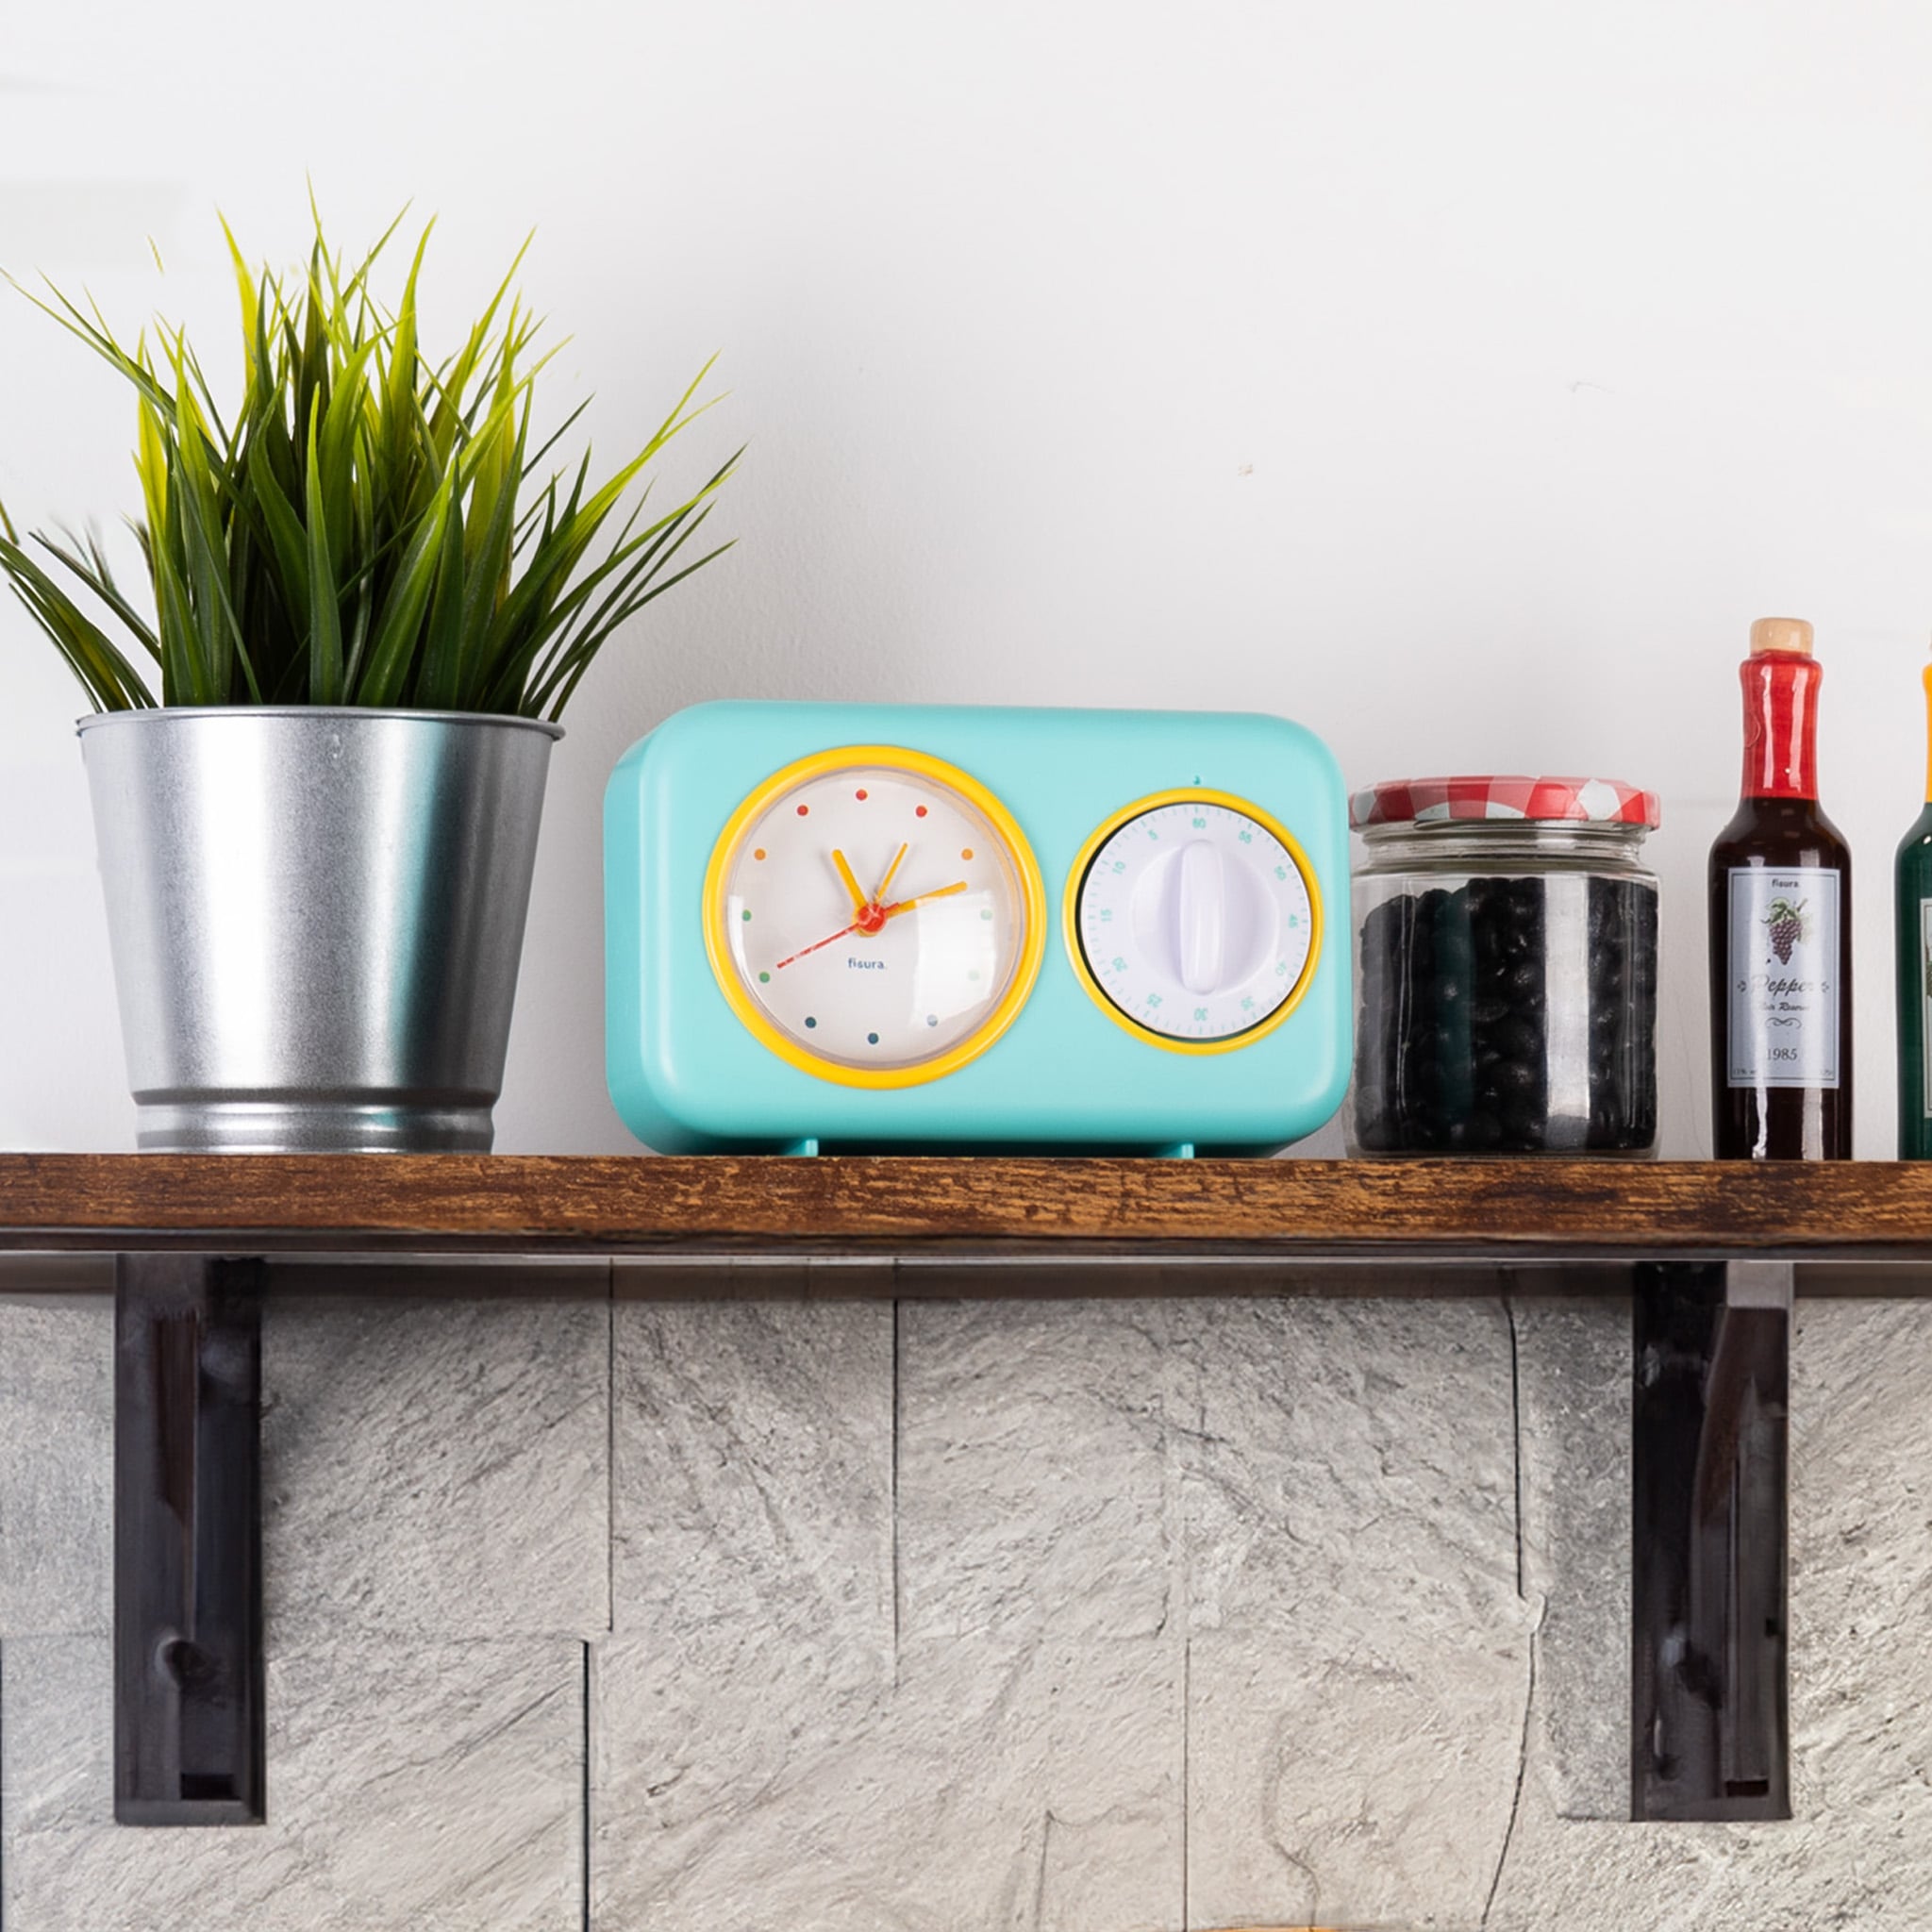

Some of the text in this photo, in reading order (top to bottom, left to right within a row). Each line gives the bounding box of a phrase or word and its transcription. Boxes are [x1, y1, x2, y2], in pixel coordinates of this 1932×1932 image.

[1192, 818, 1207, 829] 60
[1148, 829, 1158, 841] 5
[1239, 830, 1253, 844] 55
[1112, 860, 1125, 874] 10
[1274, 865, 1287, 881] 50
[1100, 908, 1112, 923] 15
[1289, 913, 1298, 928] 45
[1112, 957, 1127, 973] 20
[1275, 960, 1287, 976] 40
[1147, 993, 1163, 1008] 25
[1193, 1008, 1208, 1021] 30
[1767, 1047, 1797, 1060] 1985
